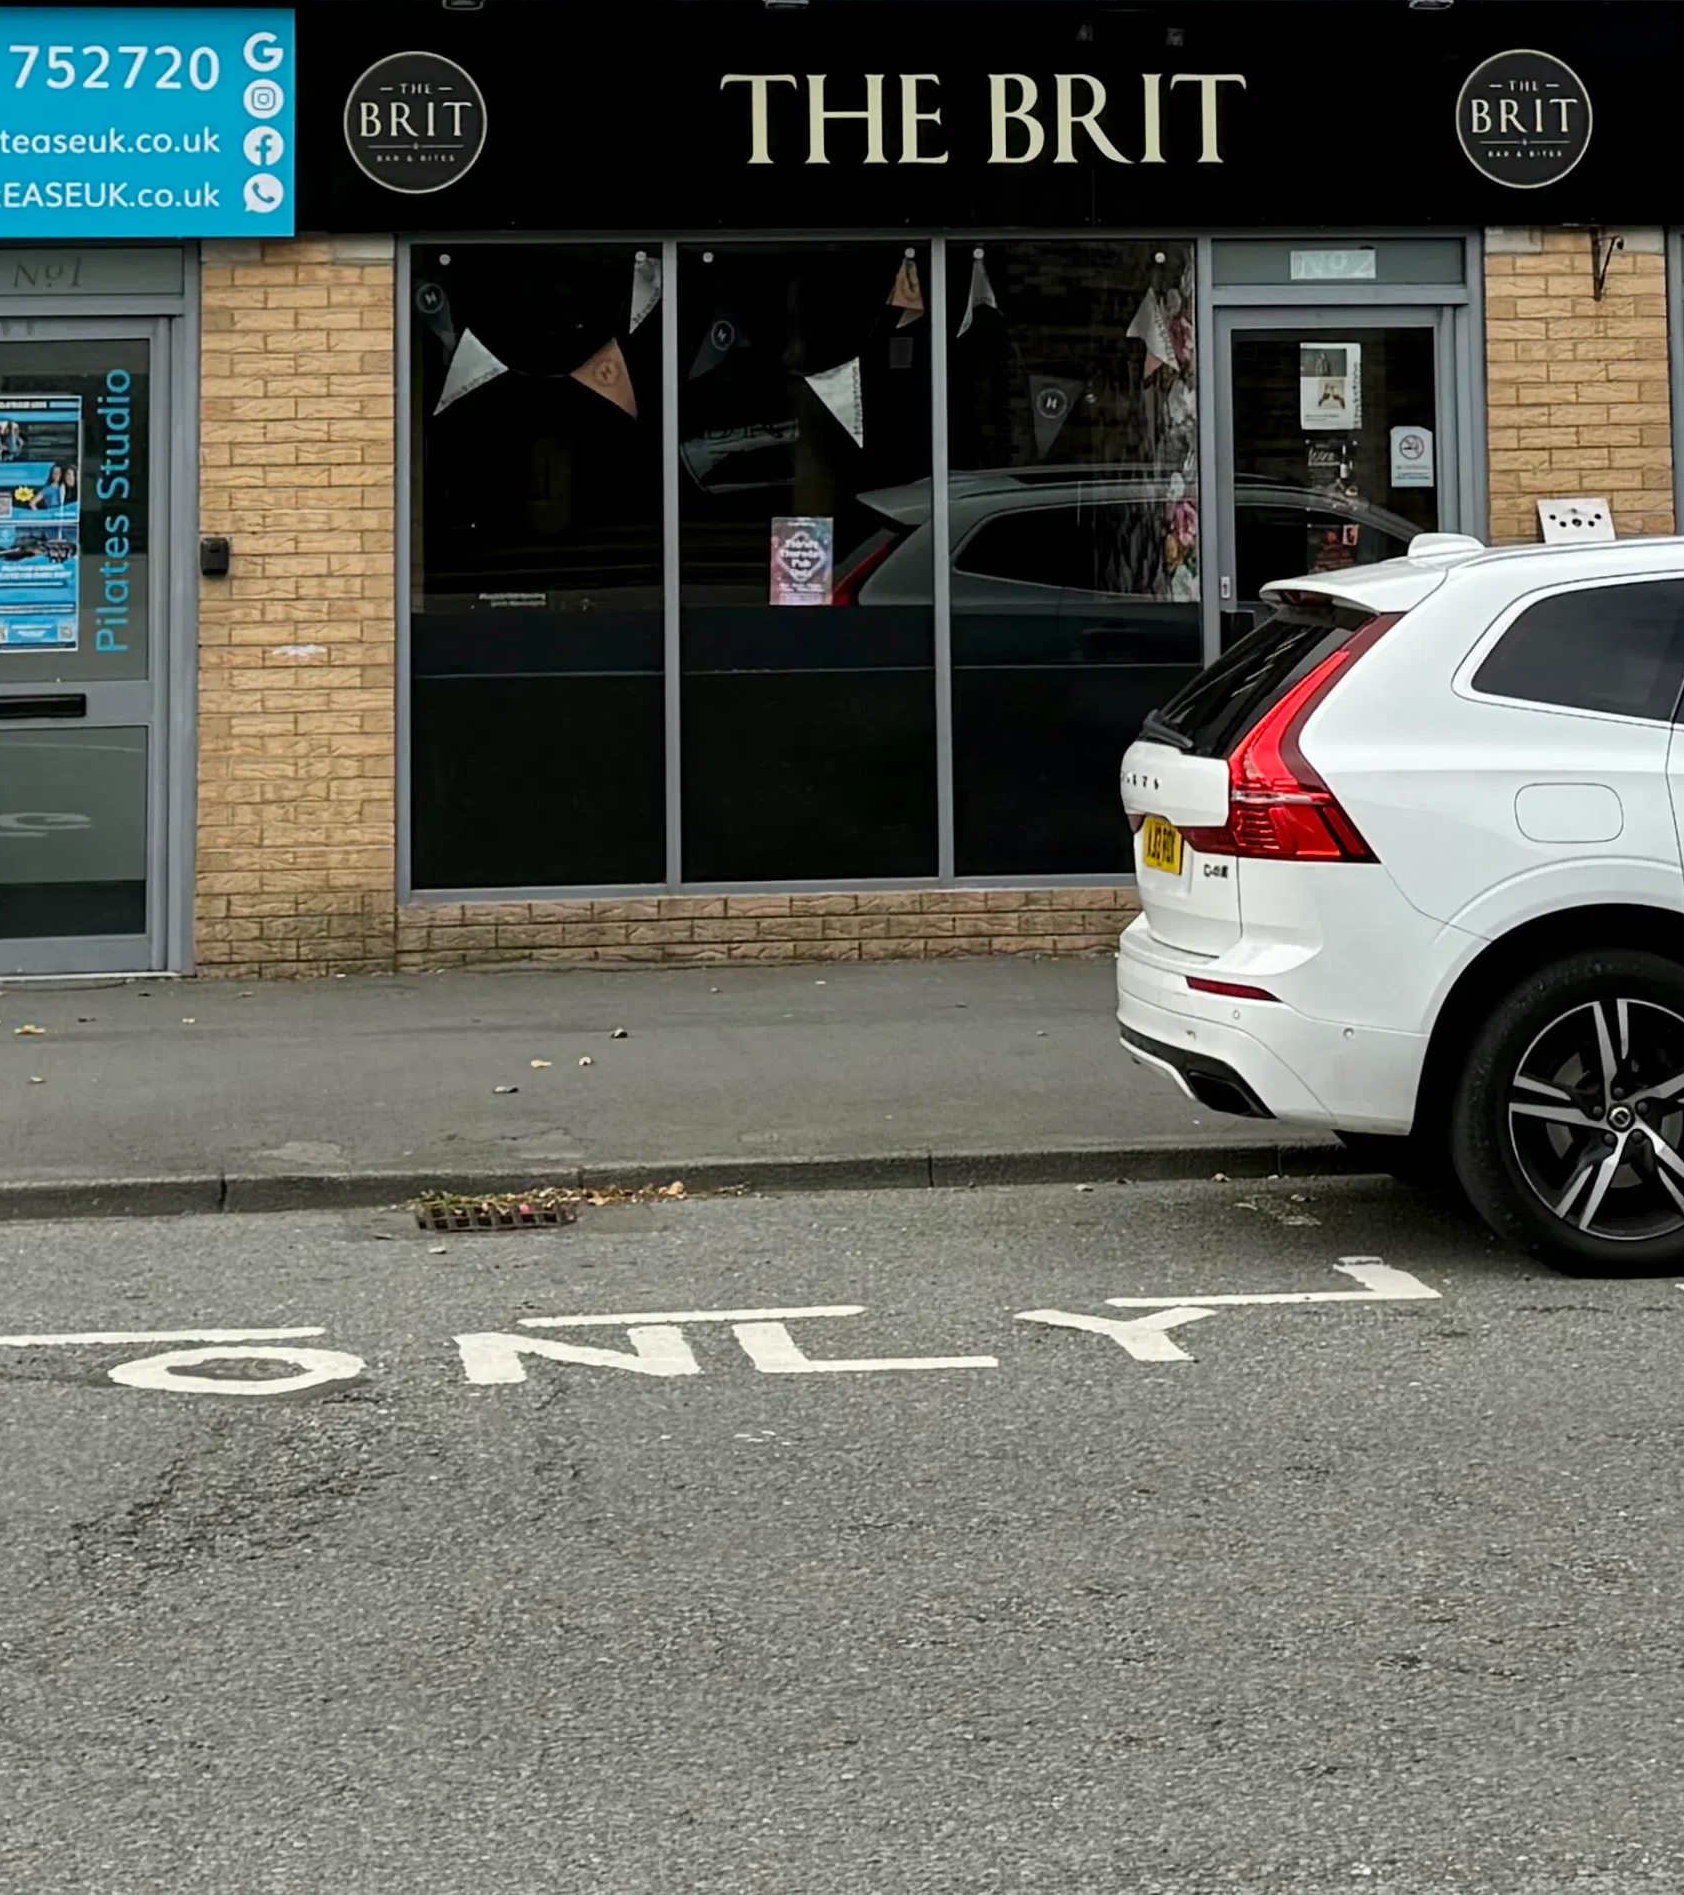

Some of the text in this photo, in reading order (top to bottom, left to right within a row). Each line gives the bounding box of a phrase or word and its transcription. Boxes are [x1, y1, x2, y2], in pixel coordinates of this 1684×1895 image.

[9, 45, 220, 91] 752720
[400, 83, 431, 95] THE
[360, 101, 473, 137] BRIT
[720, 73, 1247, 164] THE BRIT
[1471, 98, 1578, 134] BRIT
[94, 368, 131, 654] Pilates Studio
